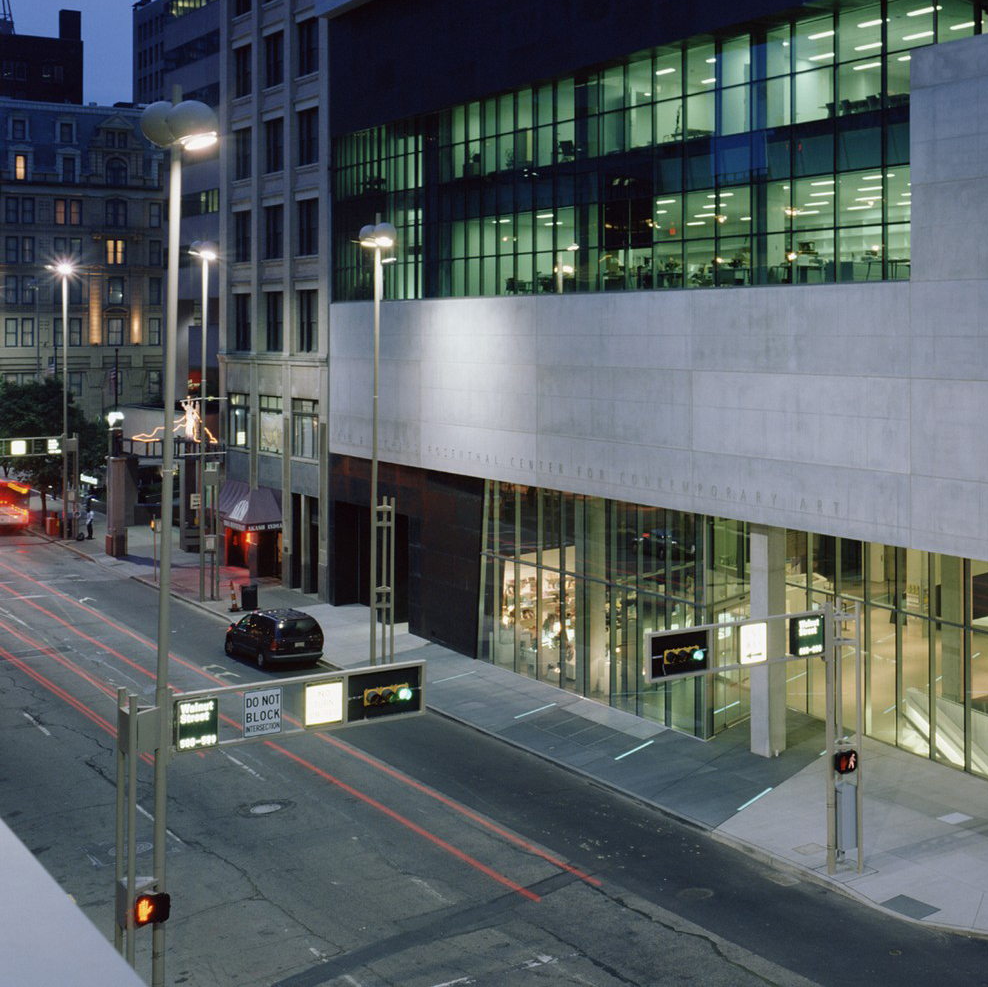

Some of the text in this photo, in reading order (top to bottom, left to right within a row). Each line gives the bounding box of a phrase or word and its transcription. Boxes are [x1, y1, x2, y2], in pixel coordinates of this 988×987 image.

[511, 457, 563, 474] CENTER
[577, 466, 604, 480] FOR
[620, 472, 777, 506] CONTEMPORARY
[801, 497, 840, 515] ART
[180, 700, 214, 714] Walnut
[246, 693, 280, 708] DO NOT
[180, 711, 210, 724] Street
[246, 708, 280, 723] BLOCK
[246, 721, 280, 733] INTERSECTION
